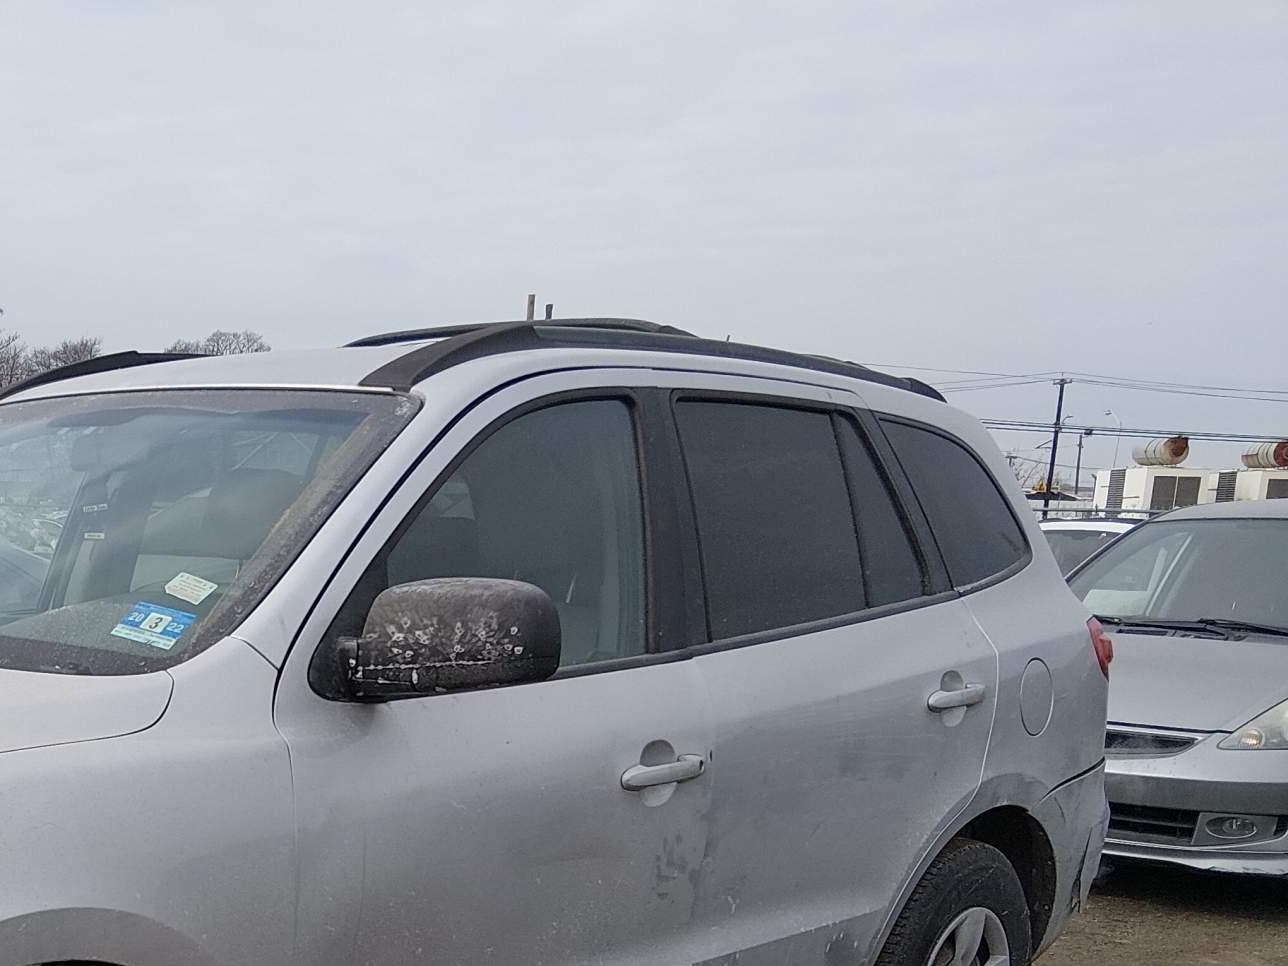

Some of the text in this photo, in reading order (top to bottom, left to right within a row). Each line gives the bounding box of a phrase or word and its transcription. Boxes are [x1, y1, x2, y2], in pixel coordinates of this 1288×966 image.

[129, 613, 190, 636] 20 3 22
